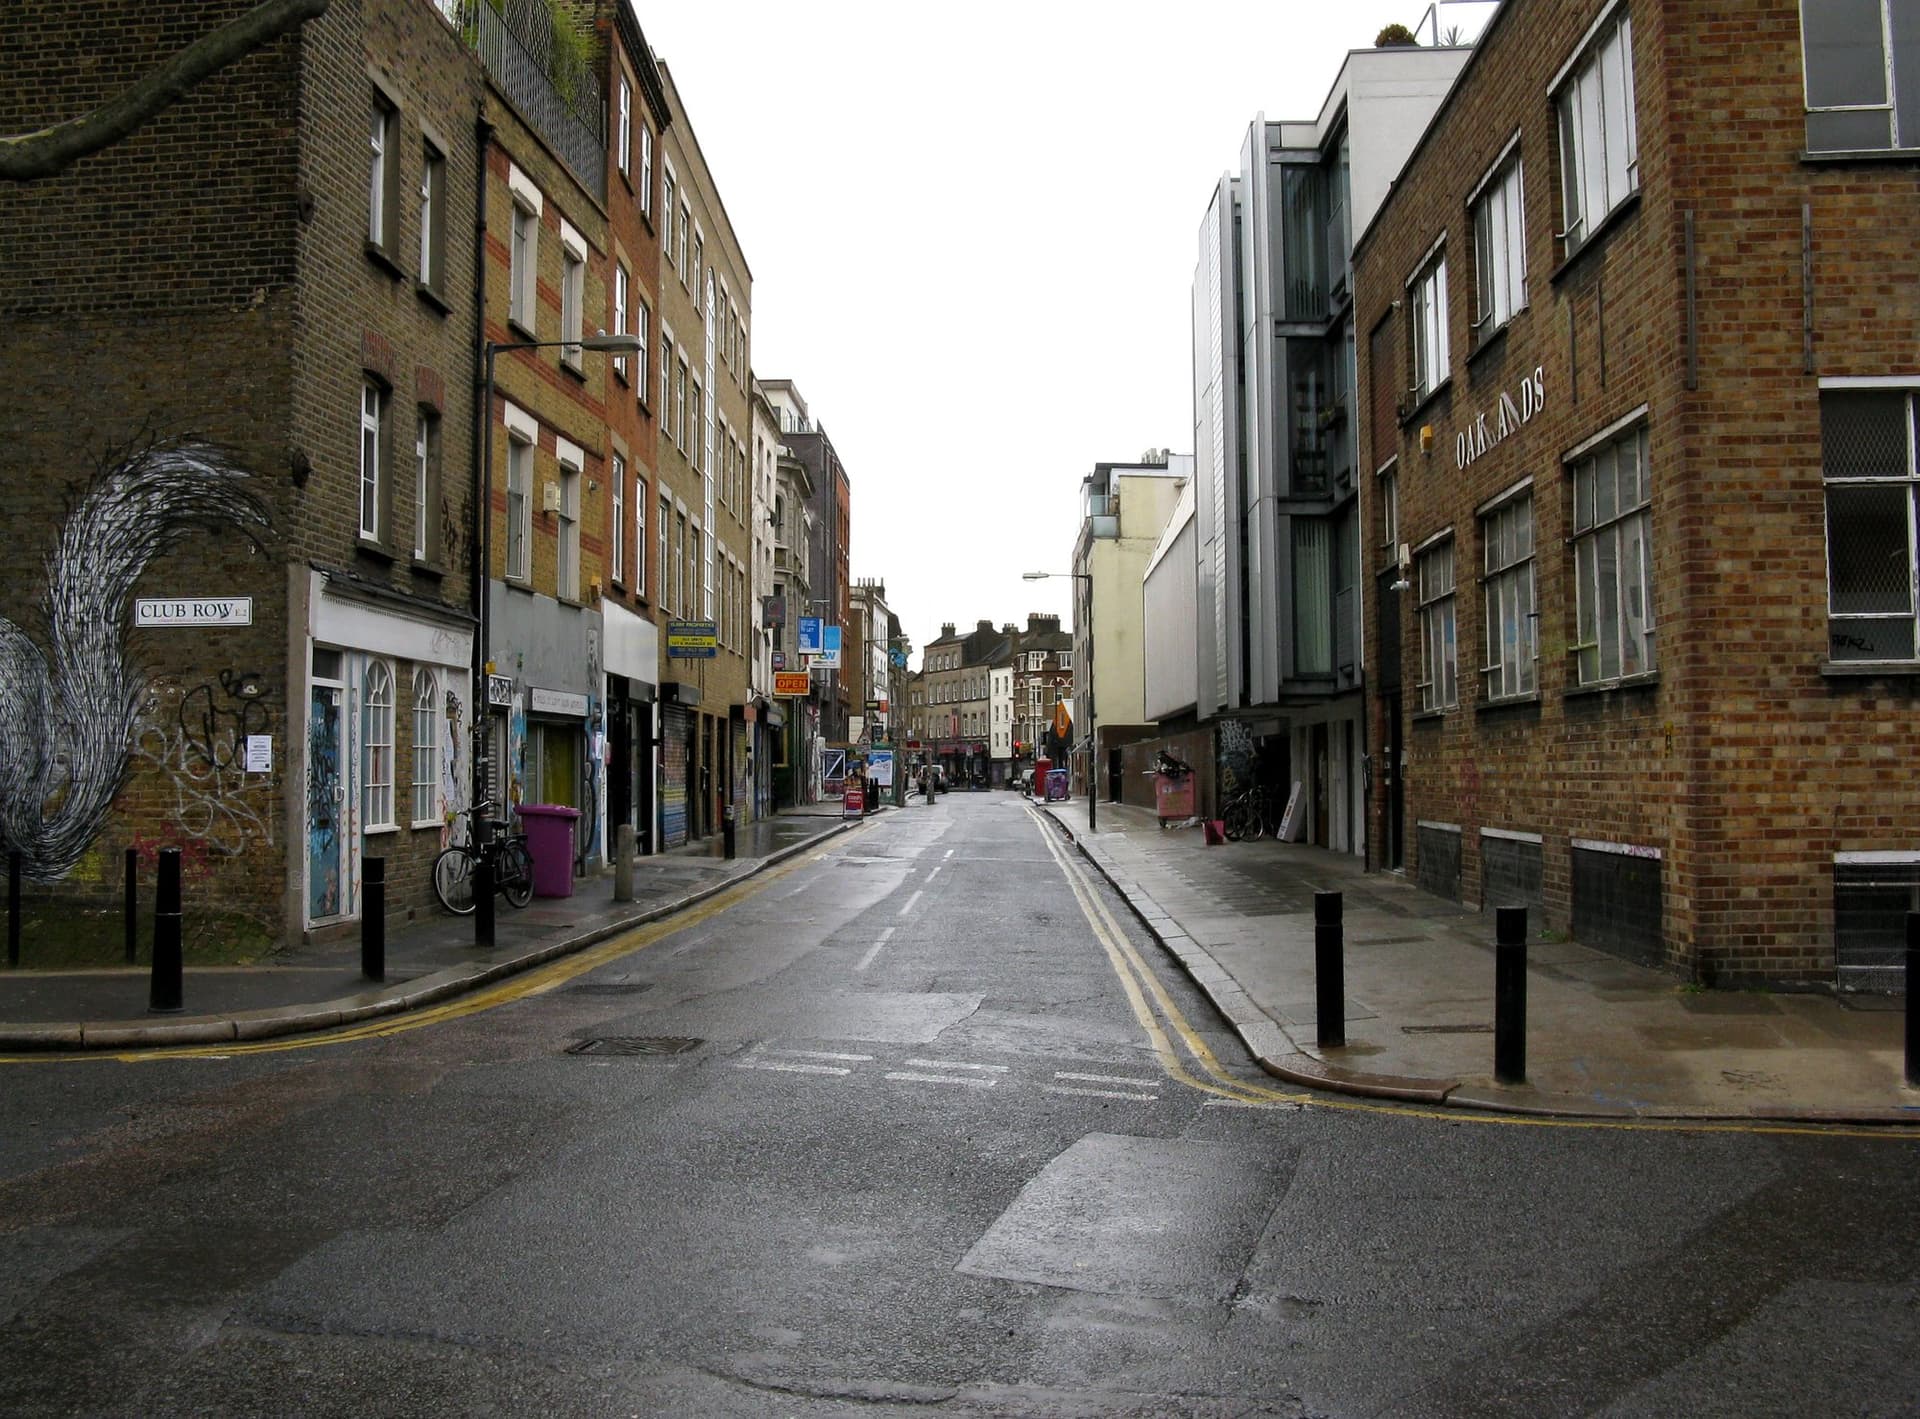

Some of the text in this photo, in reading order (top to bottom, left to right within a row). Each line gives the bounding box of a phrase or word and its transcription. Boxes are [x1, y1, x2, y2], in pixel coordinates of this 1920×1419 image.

[140, 604, 187, 618] CLUB
[193, 604, 234, 618] ROW
[777, 679, 807, 689] OPEN
